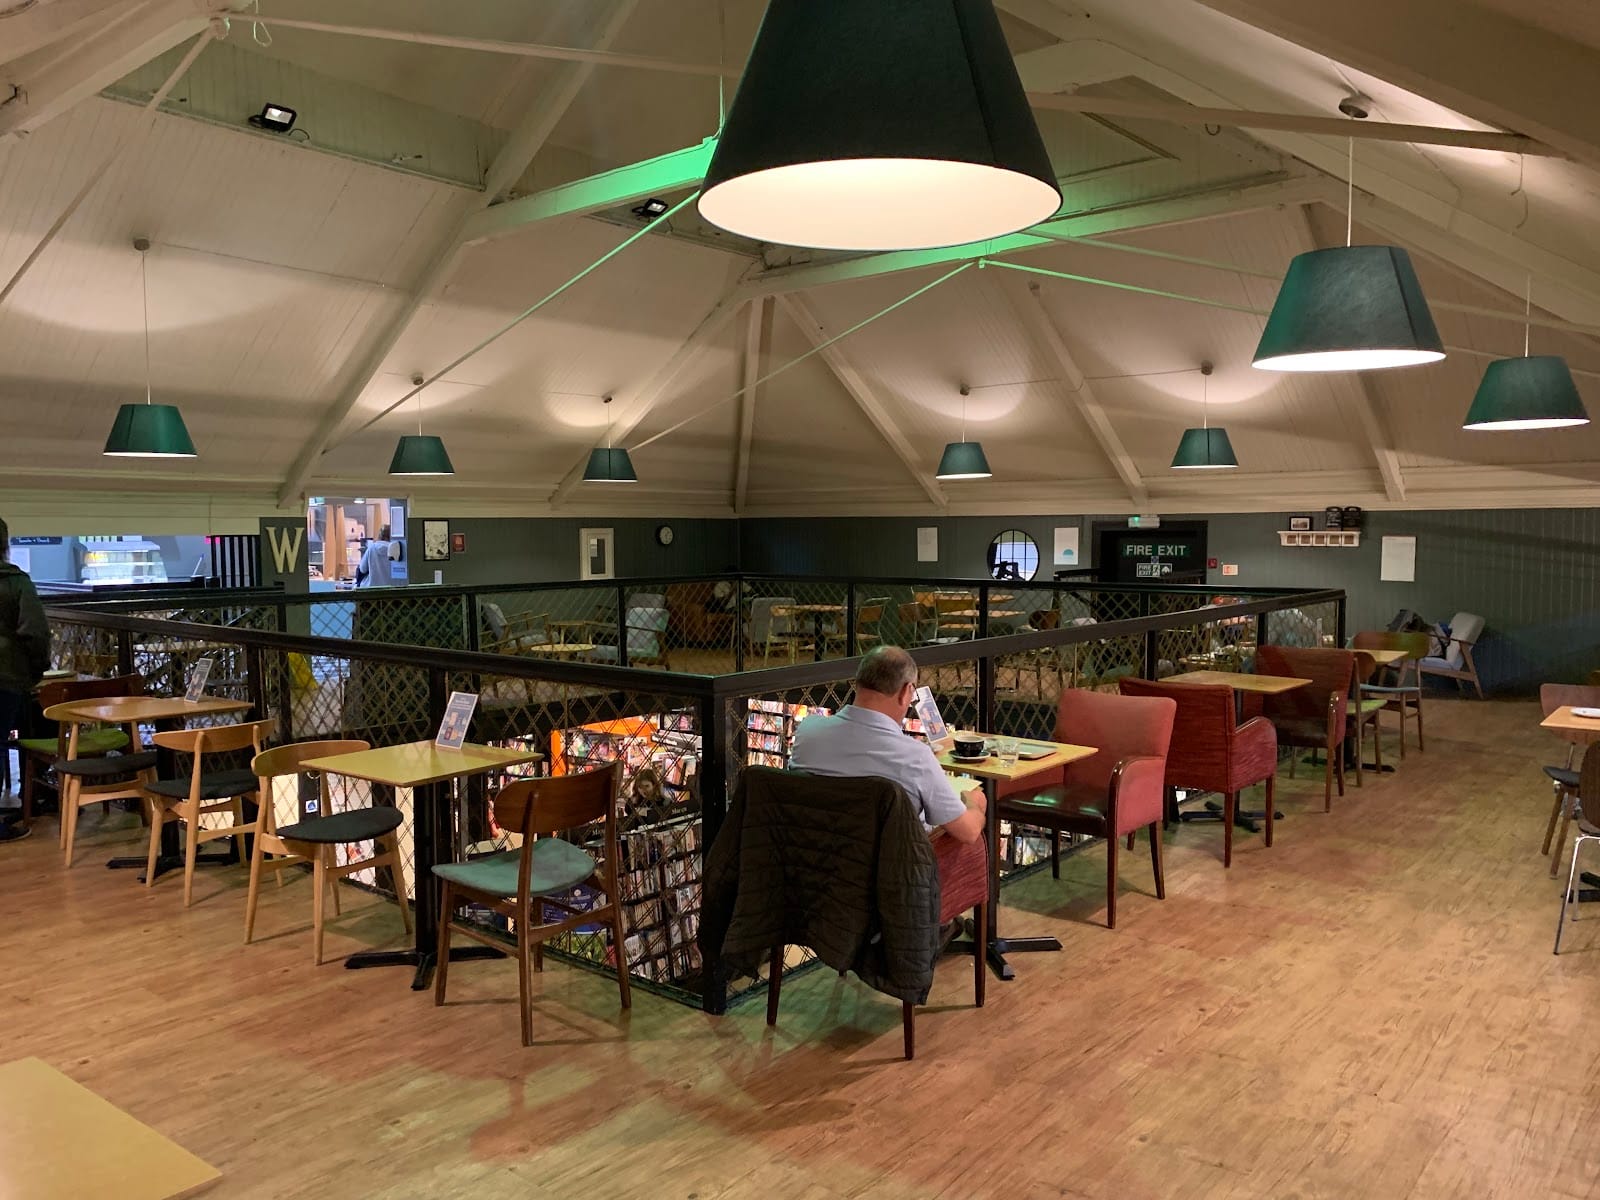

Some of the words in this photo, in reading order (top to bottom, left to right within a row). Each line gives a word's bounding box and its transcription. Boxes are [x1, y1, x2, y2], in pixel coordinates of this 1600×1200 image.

[265, 526, 305, 573] W
[1126, 545, 1153, 556] FIRE
[1157, 545, 1187, 556] EXIT
